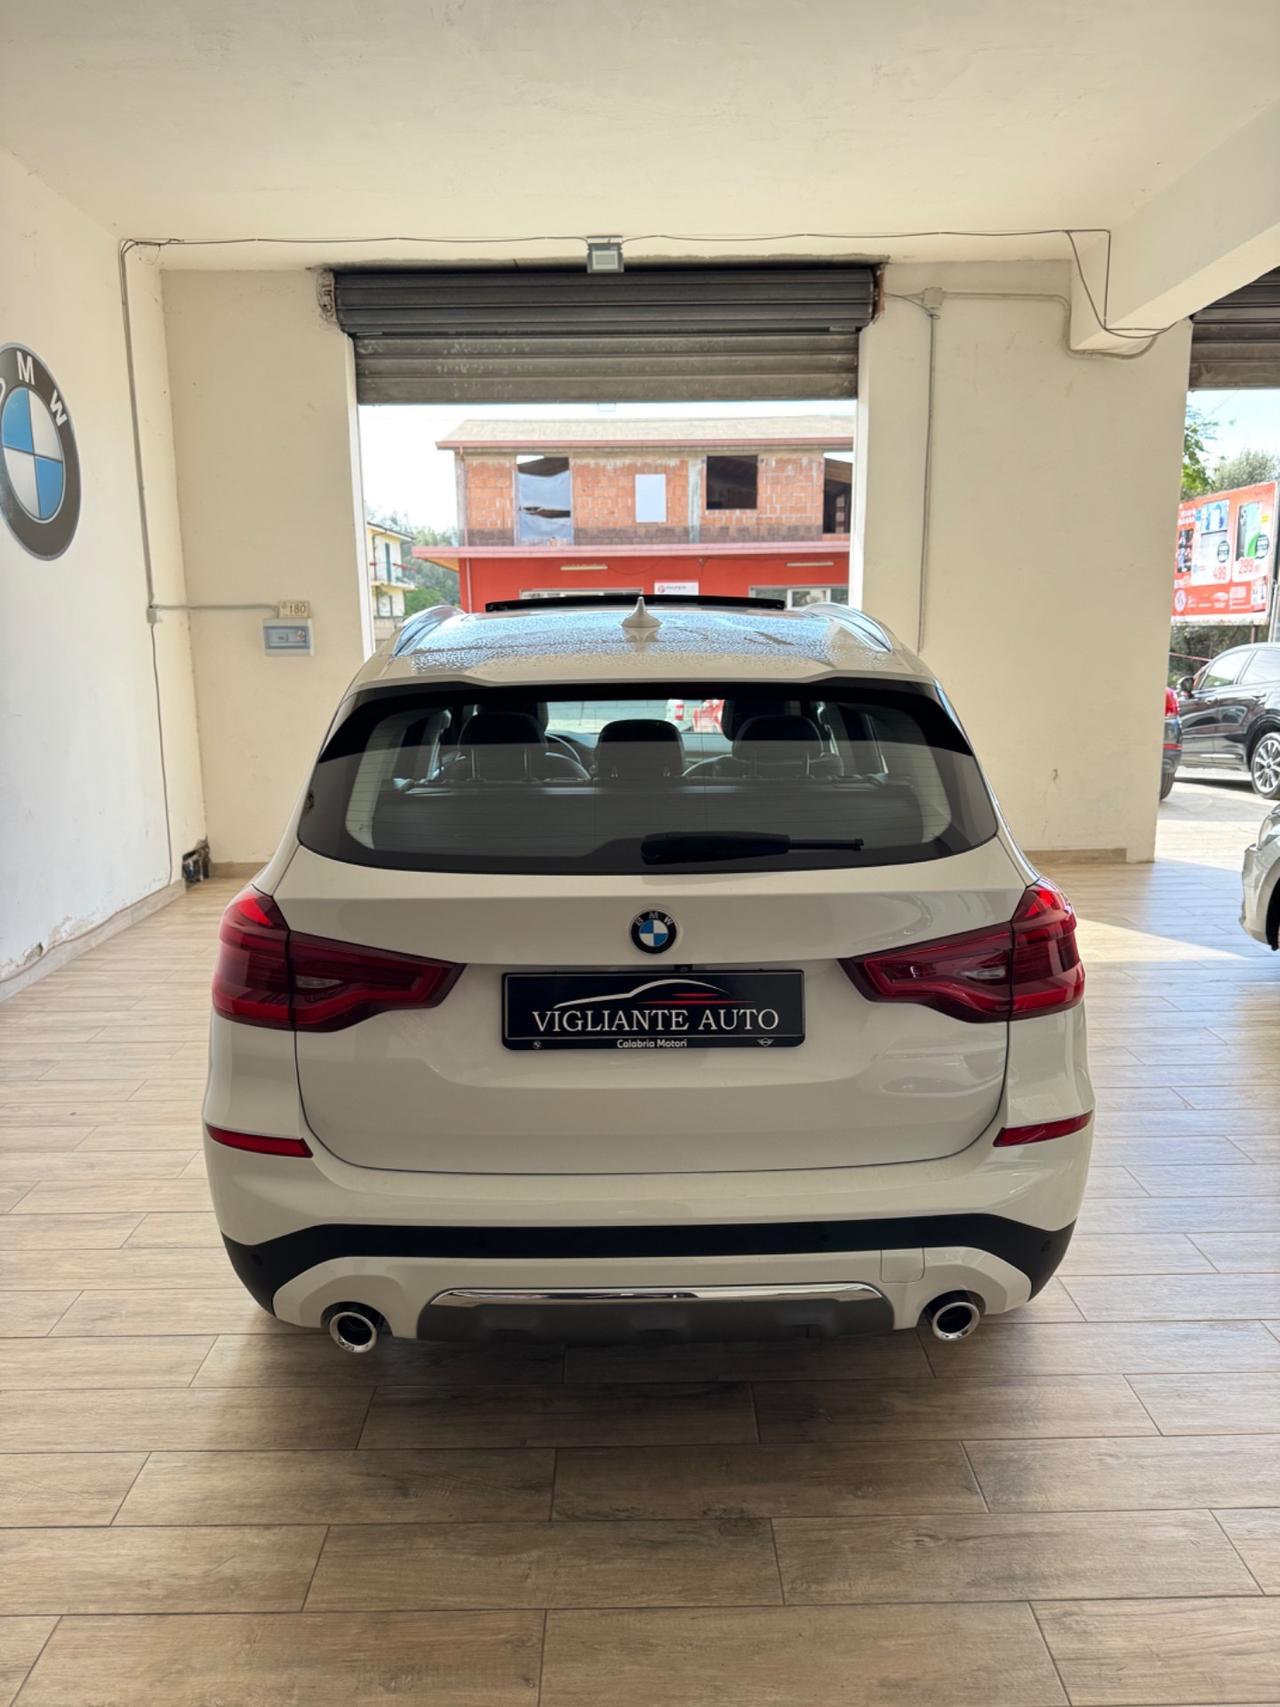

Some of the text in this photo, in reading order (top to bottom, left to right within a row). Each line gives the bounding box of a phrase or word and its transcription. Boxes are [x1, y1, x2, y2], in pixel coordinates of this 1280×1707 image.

[635, 911, 674, 926] BMW
[532, 1008, 779, 1031] VIGLIANTE AUTO
[616, 1038, 688, 1048] Calabria Motori
